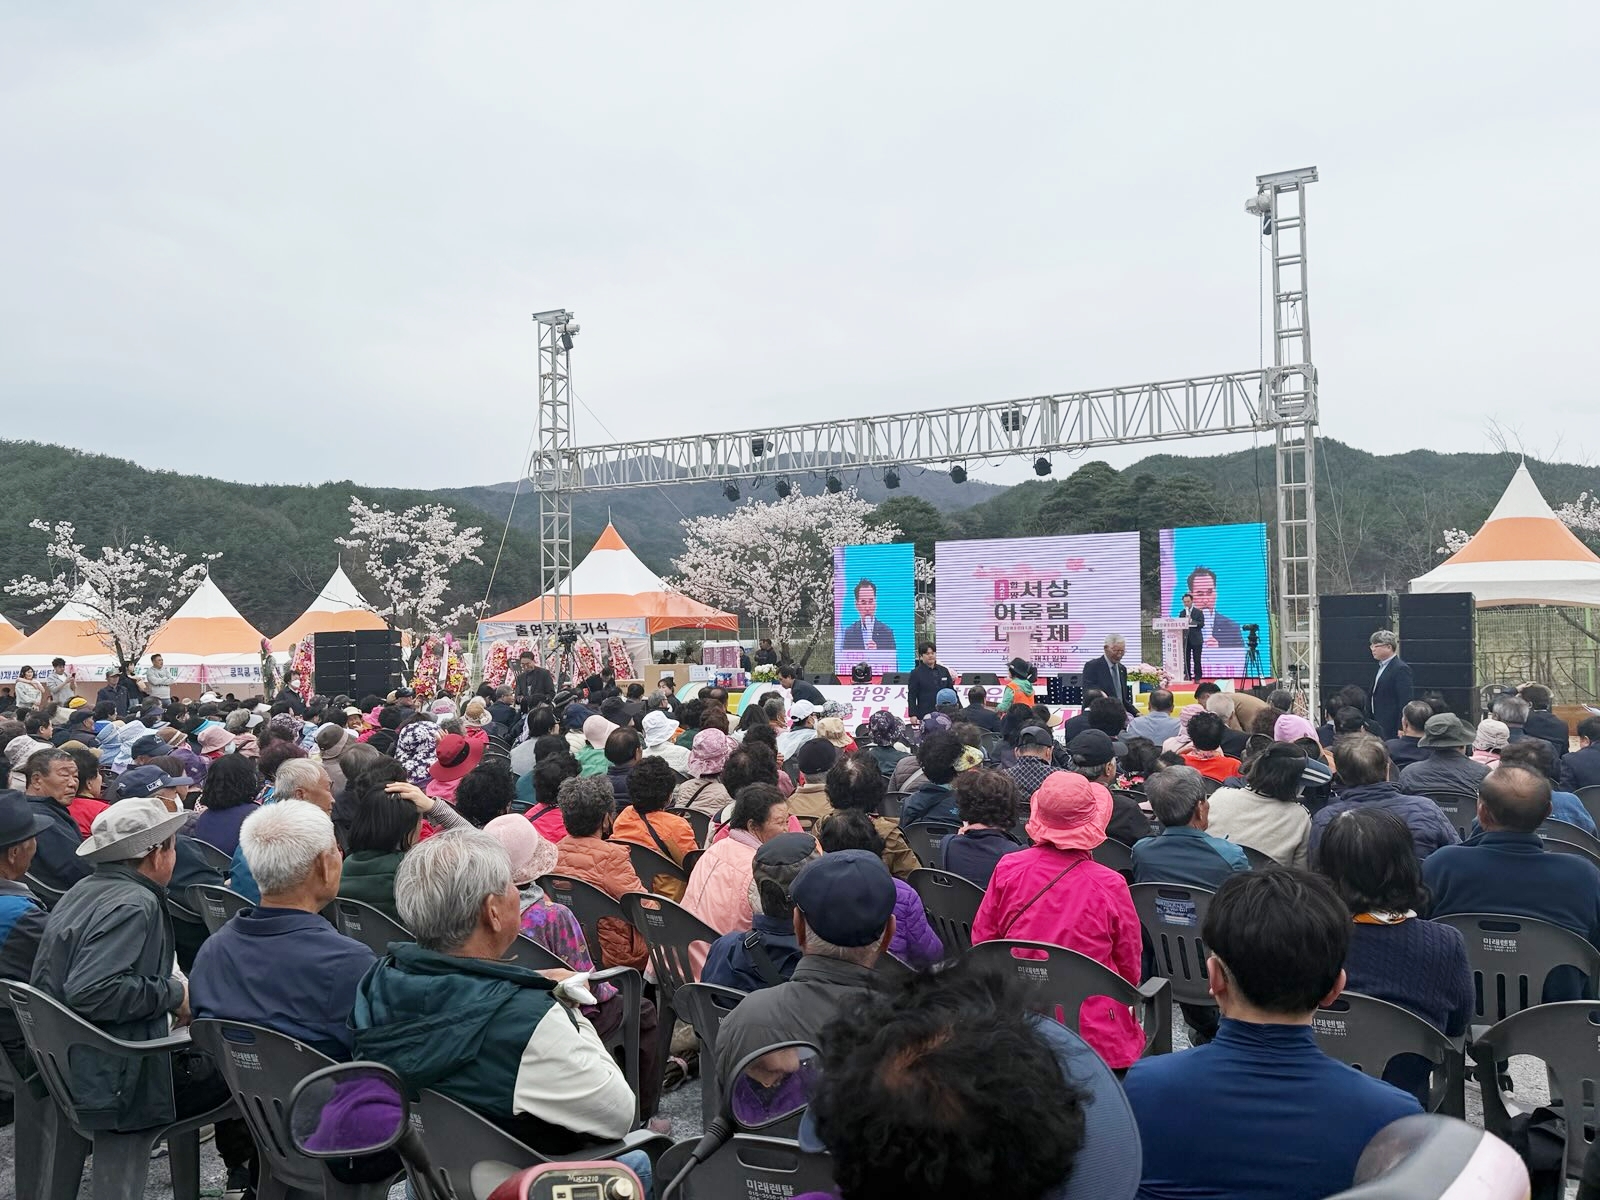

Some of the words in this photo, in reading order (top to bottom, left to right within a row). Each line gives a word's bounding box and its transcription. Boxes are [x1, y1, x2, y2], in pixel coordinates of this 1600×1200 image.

[1020, 580, 1072, 598] 서상
[994, 602, 1069, 620] 어울림
[852, 686, 892, 702] 함양
[1483, 937, 1517, 947] 미래렌탈
[746, 1179, 794, 1196] 미래렌탈
